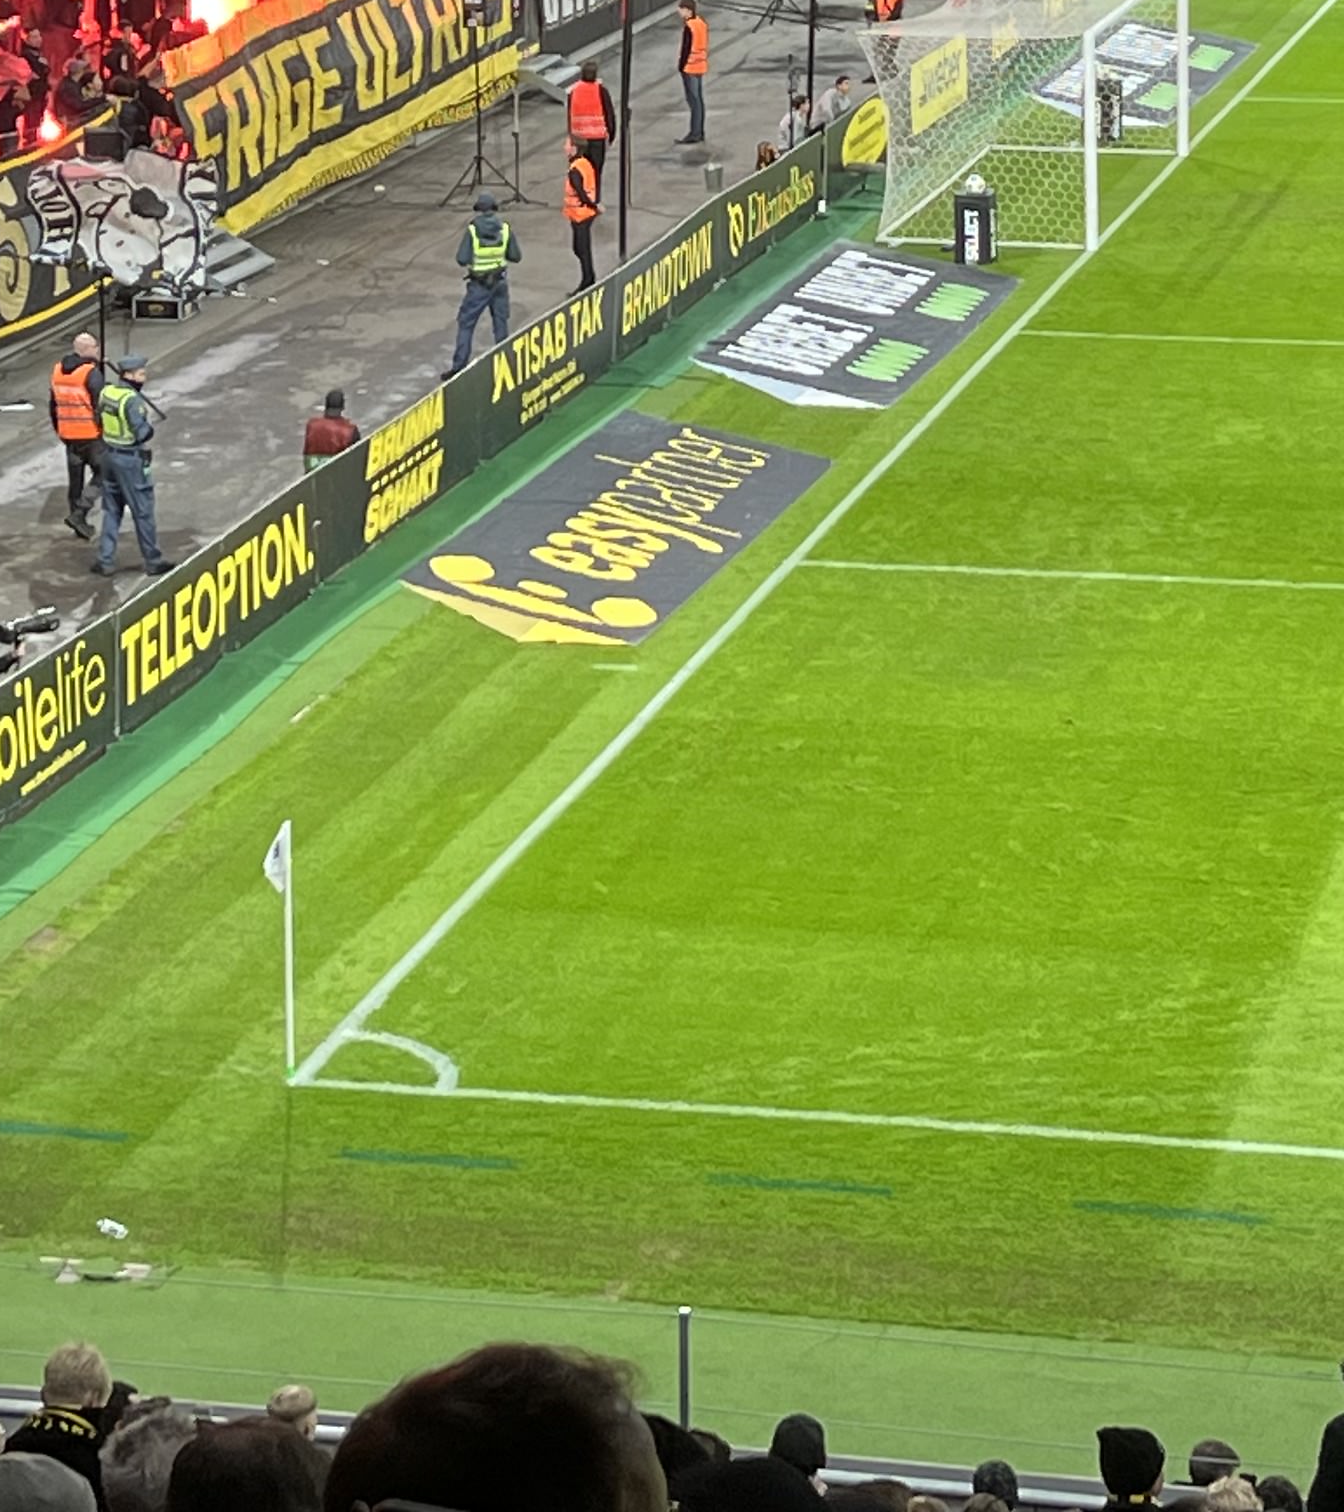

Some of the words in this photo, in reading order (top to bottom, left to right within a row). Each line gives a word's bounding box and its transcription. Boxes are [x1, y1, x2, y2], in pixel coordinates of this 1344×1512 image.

[512, 311, 567, 386] TISAB
[569, 286, 605, 348] TAK
[621, 220, 714, 336] BRANDTOWN
[528, 426, 774, 582] easypartner
